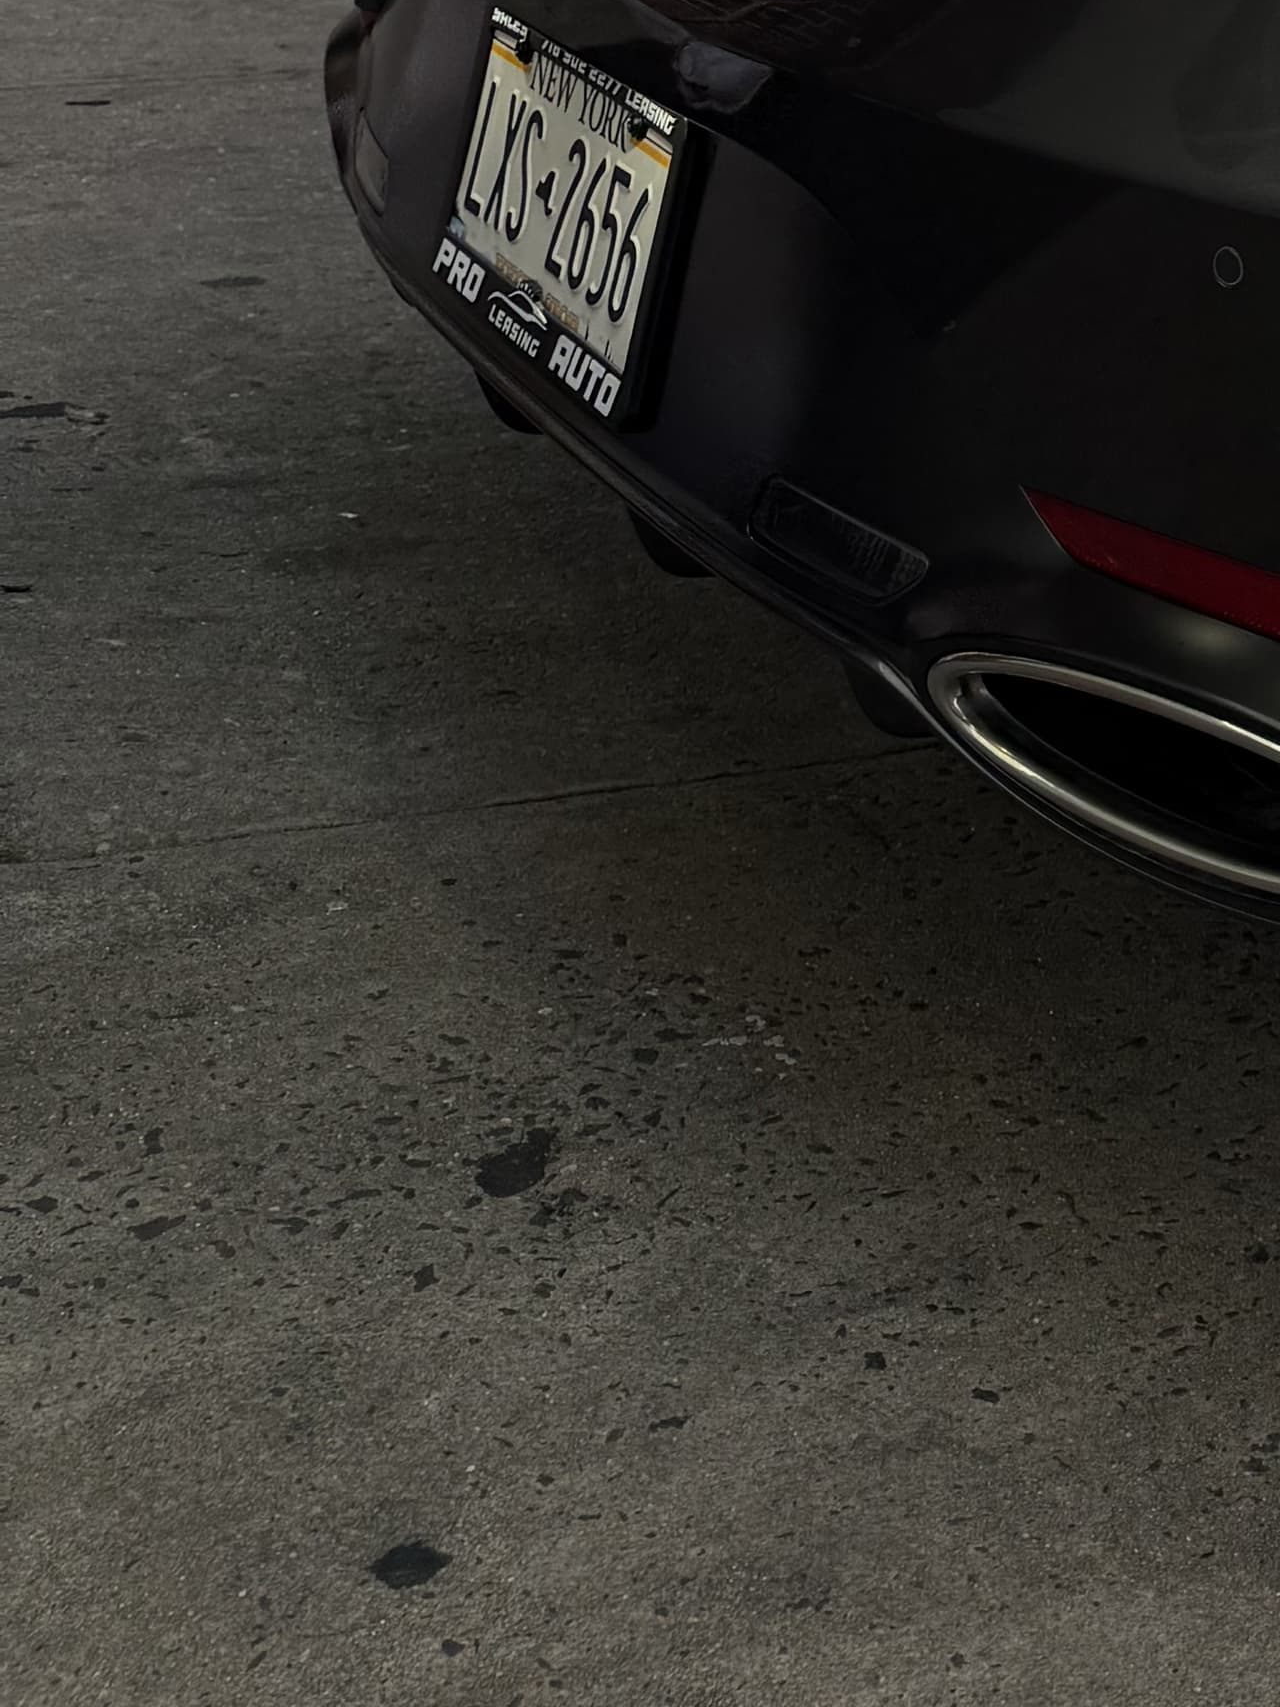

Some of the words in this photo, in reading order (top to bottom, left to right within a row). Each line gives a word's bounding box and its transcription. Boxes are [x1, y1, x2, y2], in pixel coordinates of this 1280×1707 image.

[530, 51, 580, 113] NEW
[578, 81, 630, 151] YORK
[625, 88, 677, 136] LEASING
[463, 78, 545, 243] LXS
[544, 137, 652, 325] 2656
[431, 236, 487, 304] PRO
[547, 333, 622, 419] AUTO
[487, 303, 543, 359] LEASING
